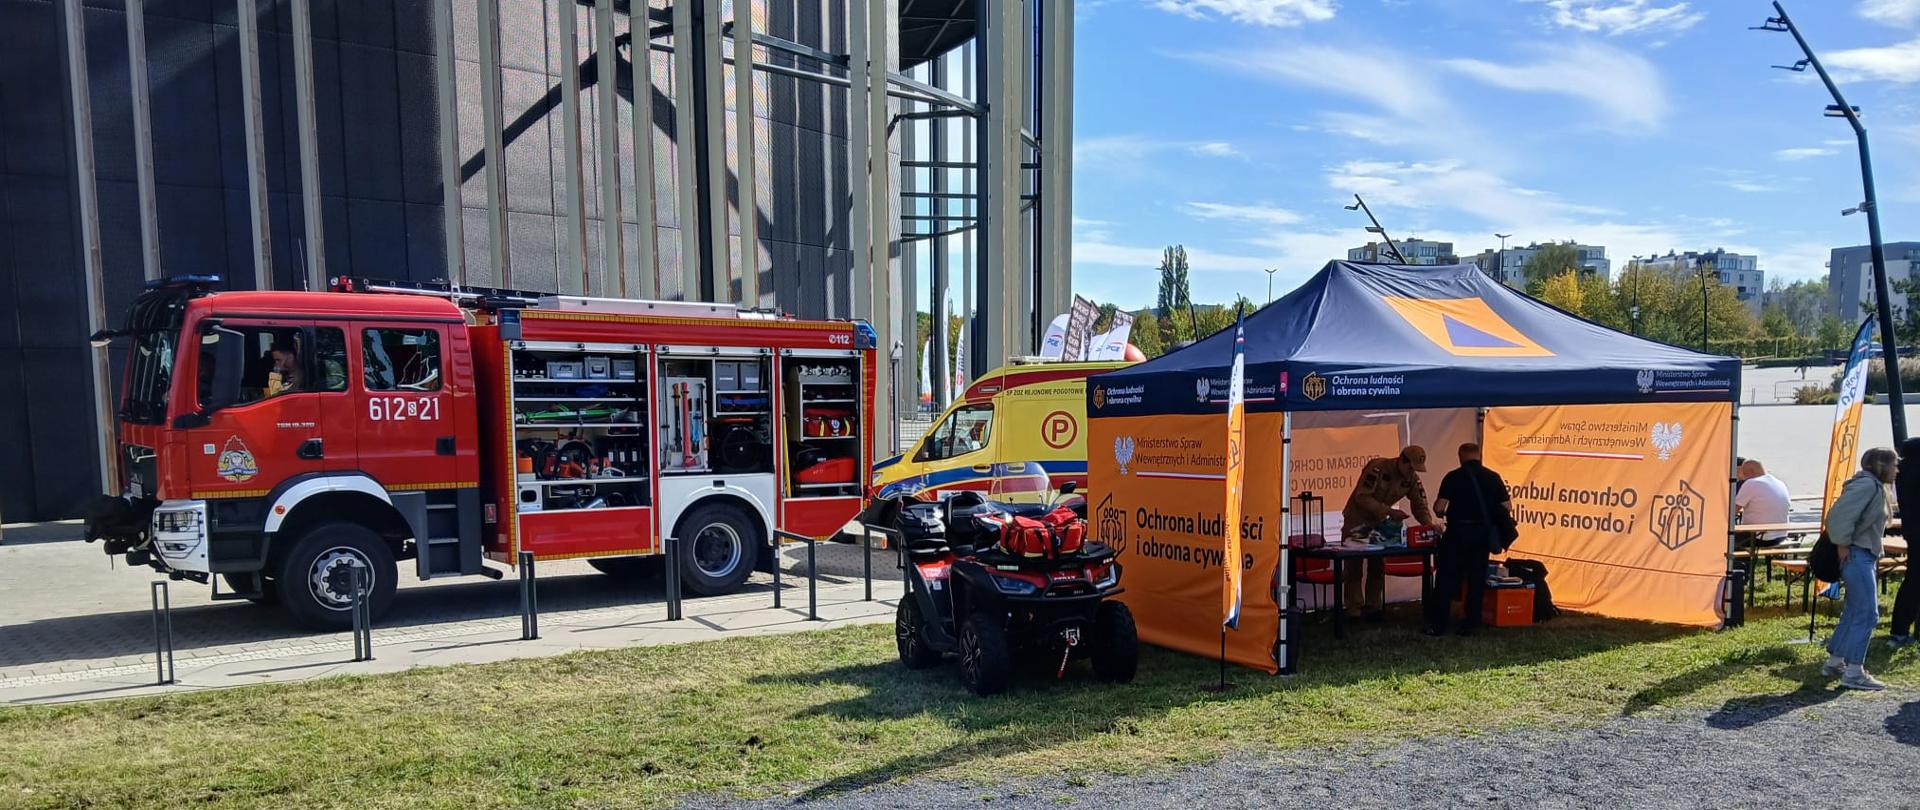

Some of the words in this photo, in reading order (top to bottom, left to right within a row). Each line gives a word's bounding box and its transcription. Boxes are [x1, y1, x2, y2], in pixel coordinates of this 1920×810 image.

[836, 335, 849, 344] 112
[1332, 375, 1368, 385] Ochrona
[1370, 374, 1404, 385] ludności
[1337, 386, 1367, 396] obrona
[1368, 386, 1401, 397] cywilna
[1052, 419, 1069, 442] P
[1136, 437, 1179, 449] Ministerstwo
[1180, 437, 1203, 451] Spraw
[1136, 453, 1185, 466] Wewnętrznych
[1192, 455, 1227, 468] Administr
[1136, 507, 1194, 534] Ochrona
[1197, 512, 1263, 541] ludści
[1136, 535, 1140, 555] i
[1143, 536, 1191, 562] obrona
